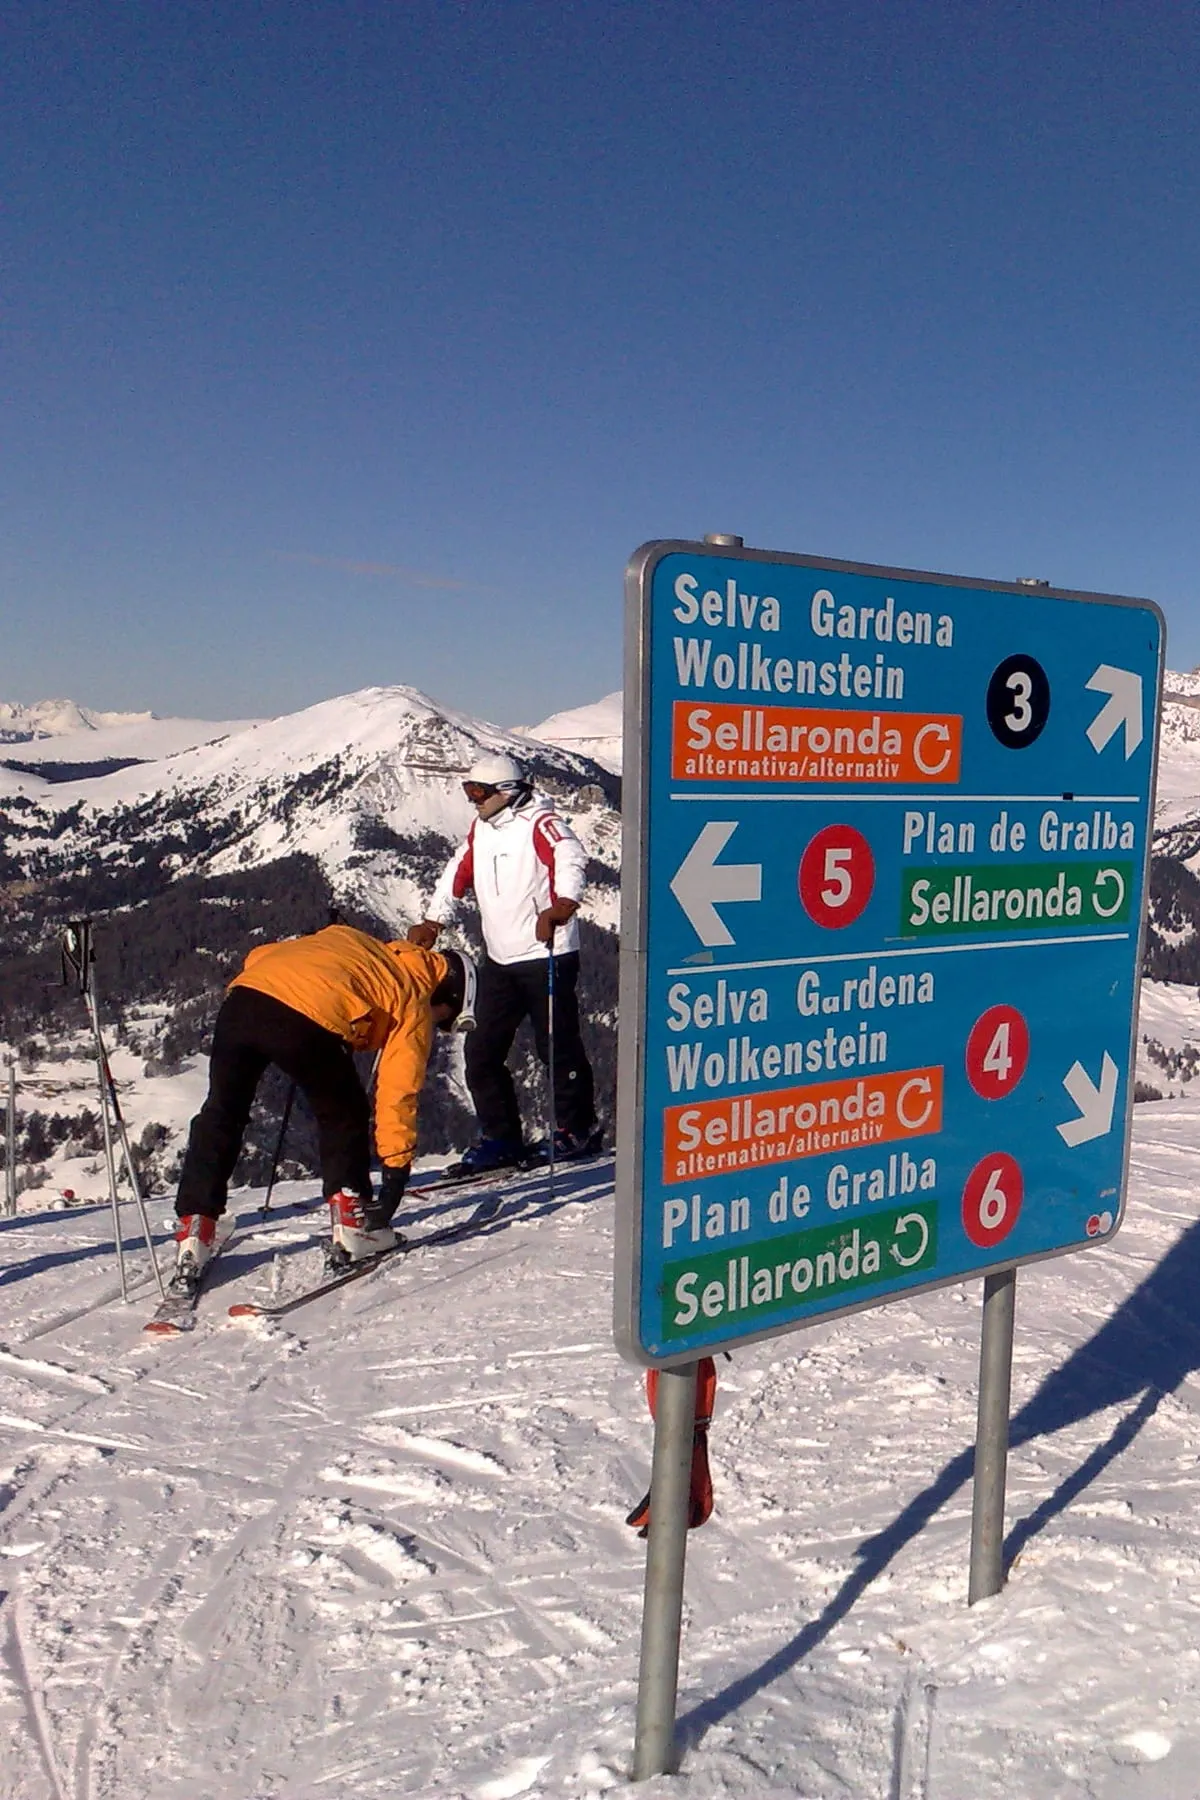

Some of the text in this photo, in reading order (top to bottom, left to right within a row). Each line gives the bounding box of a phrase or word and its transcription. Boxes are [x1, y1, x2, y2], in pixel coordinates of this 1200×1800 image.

[673, 573, 953, 647] Selva Gardena
[673, 637, 904, 699] Wolkenstein
[1004, 671, 1032, 732] 3
[687, 709, 902, 755] Sellaronda
[684, 753, 900, 778] alternativa/alternativ
[903, 810, 1134, 854] Plan de Gralba
[821, 848, 852, 907] 5
[909, 872, 1082, 926] Sellaronda
[667, 979, 768, 1032] Selva
[666, 1022, 887, 1092] Wolkenstein
[983, 1022, 1012, 1081] 4
[678, 1082, 885, 1151] Sellaronda
[676, 1123, 883, 1177] alternativa/alternativ
[662, 1152, 936, 1248] Plan de Gralba
[979, 1168, 1007, 1229] 6
[674, 1229, 880, 1326] Sellaronda
